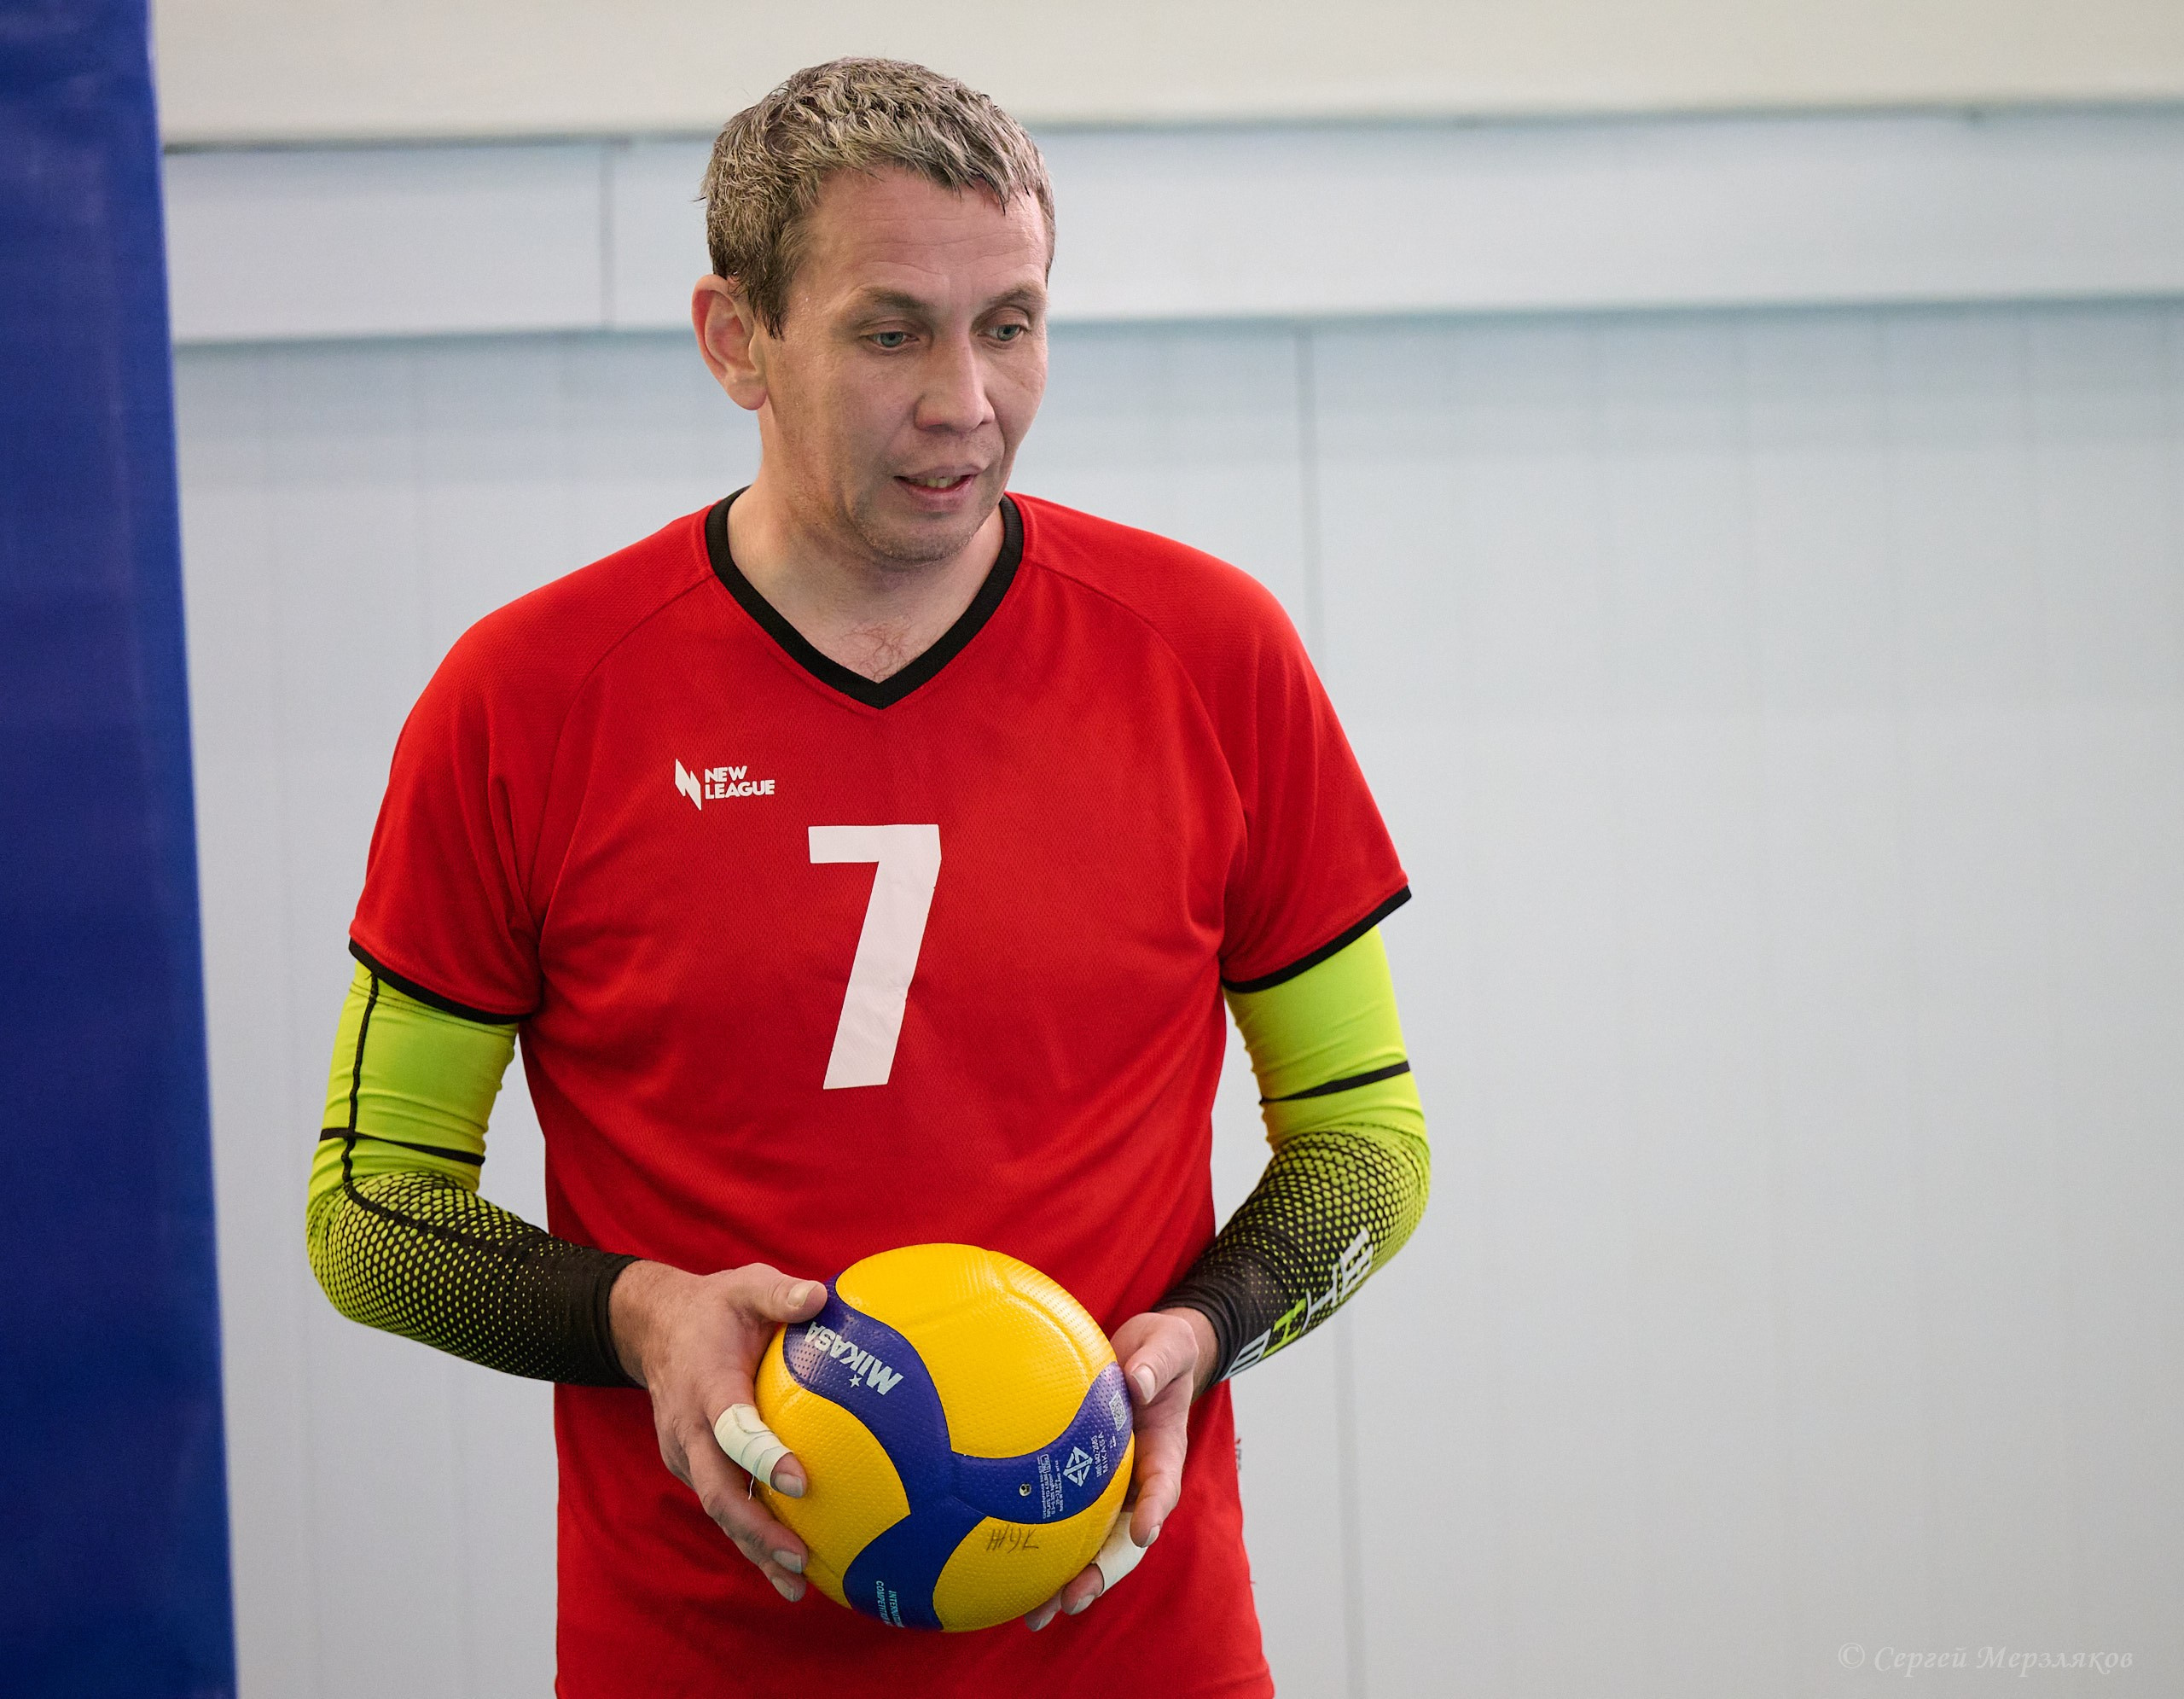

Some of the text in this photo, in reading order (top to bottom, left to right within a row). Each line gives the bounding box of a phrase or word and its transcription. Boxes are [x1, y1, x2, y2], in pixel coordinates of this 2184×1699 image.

[705, 765, 747, 783] NEW
[705, 779, 775, 800] LEAGUE
[808, 824, 942, 1090] 7
[804, 1321, 904, 1395] MIKASA
[1098, 1431, 1110, 1474] MIKASA
